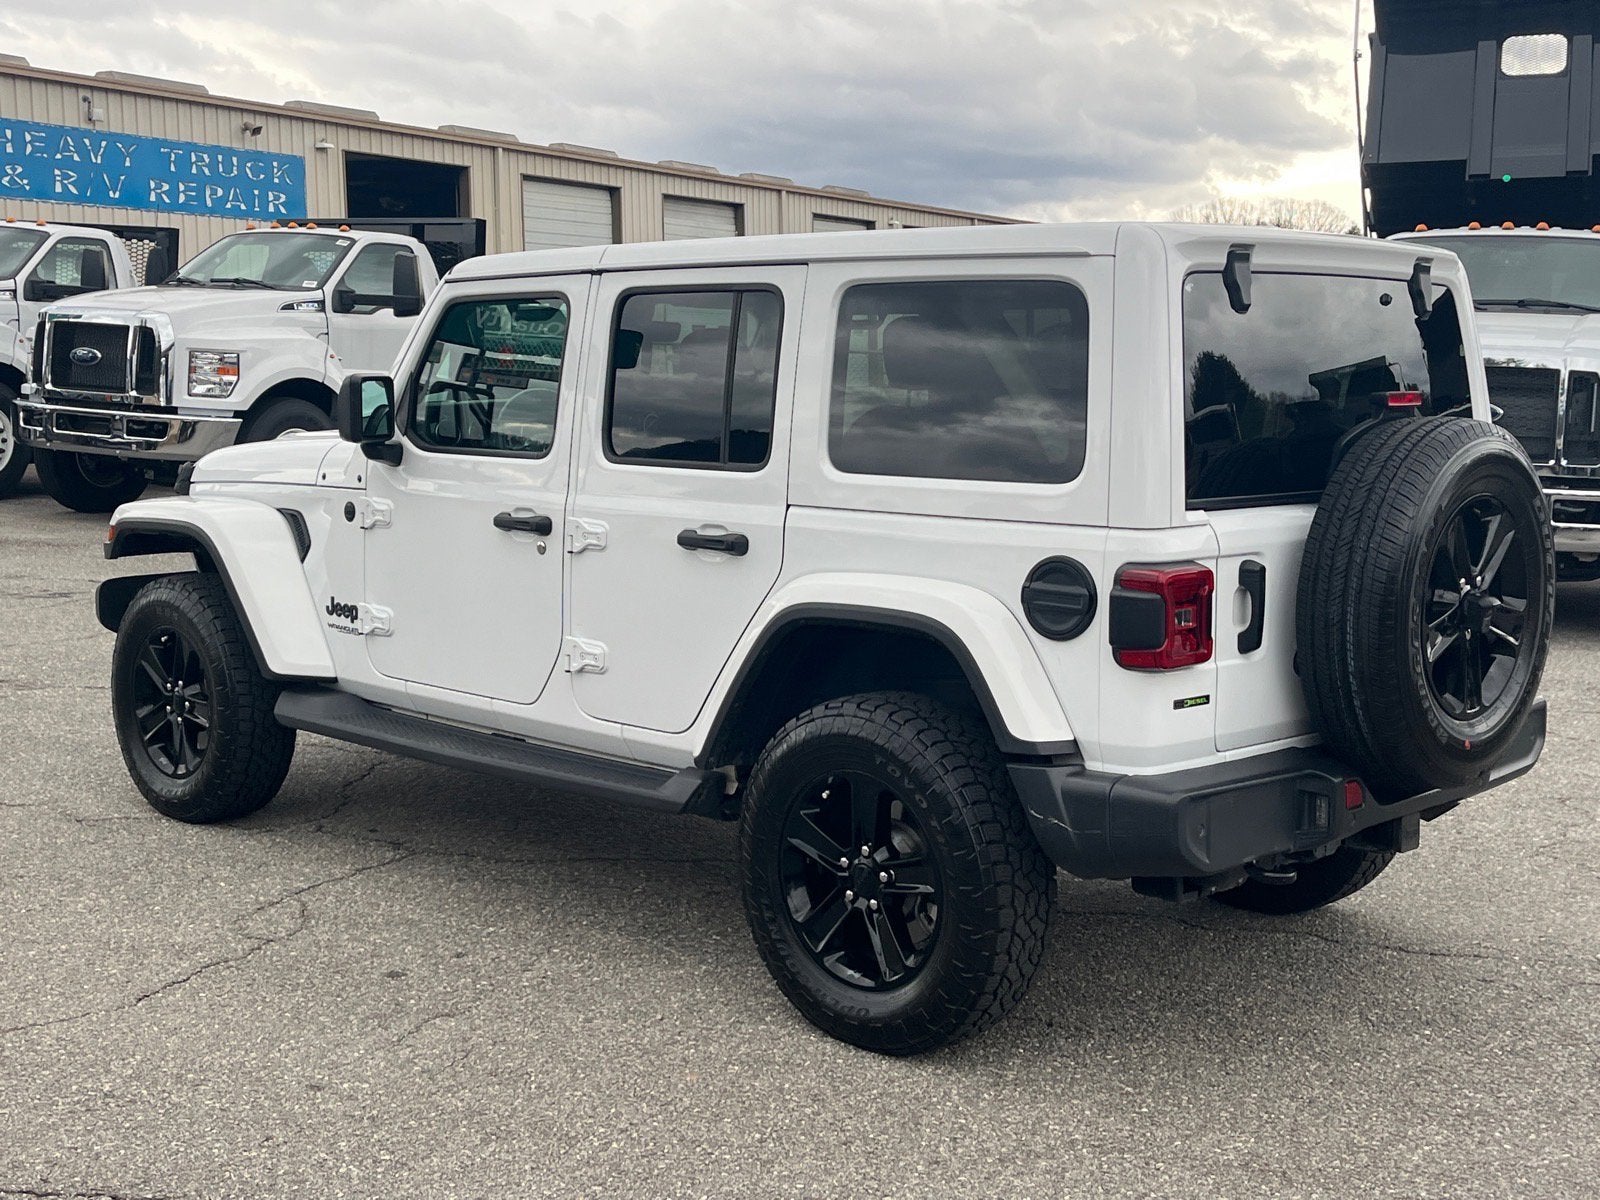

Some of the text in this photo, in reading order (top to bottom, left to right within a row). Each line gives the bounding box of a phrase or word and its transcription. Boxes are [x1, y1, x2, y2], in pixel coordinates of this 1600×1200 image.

[160, 147, 293, 186] TRUCK
[1, 164, 31, 191] &
[149, 178, 288, 214] REPAIR
[326, 596, 359, 623] Jeep
